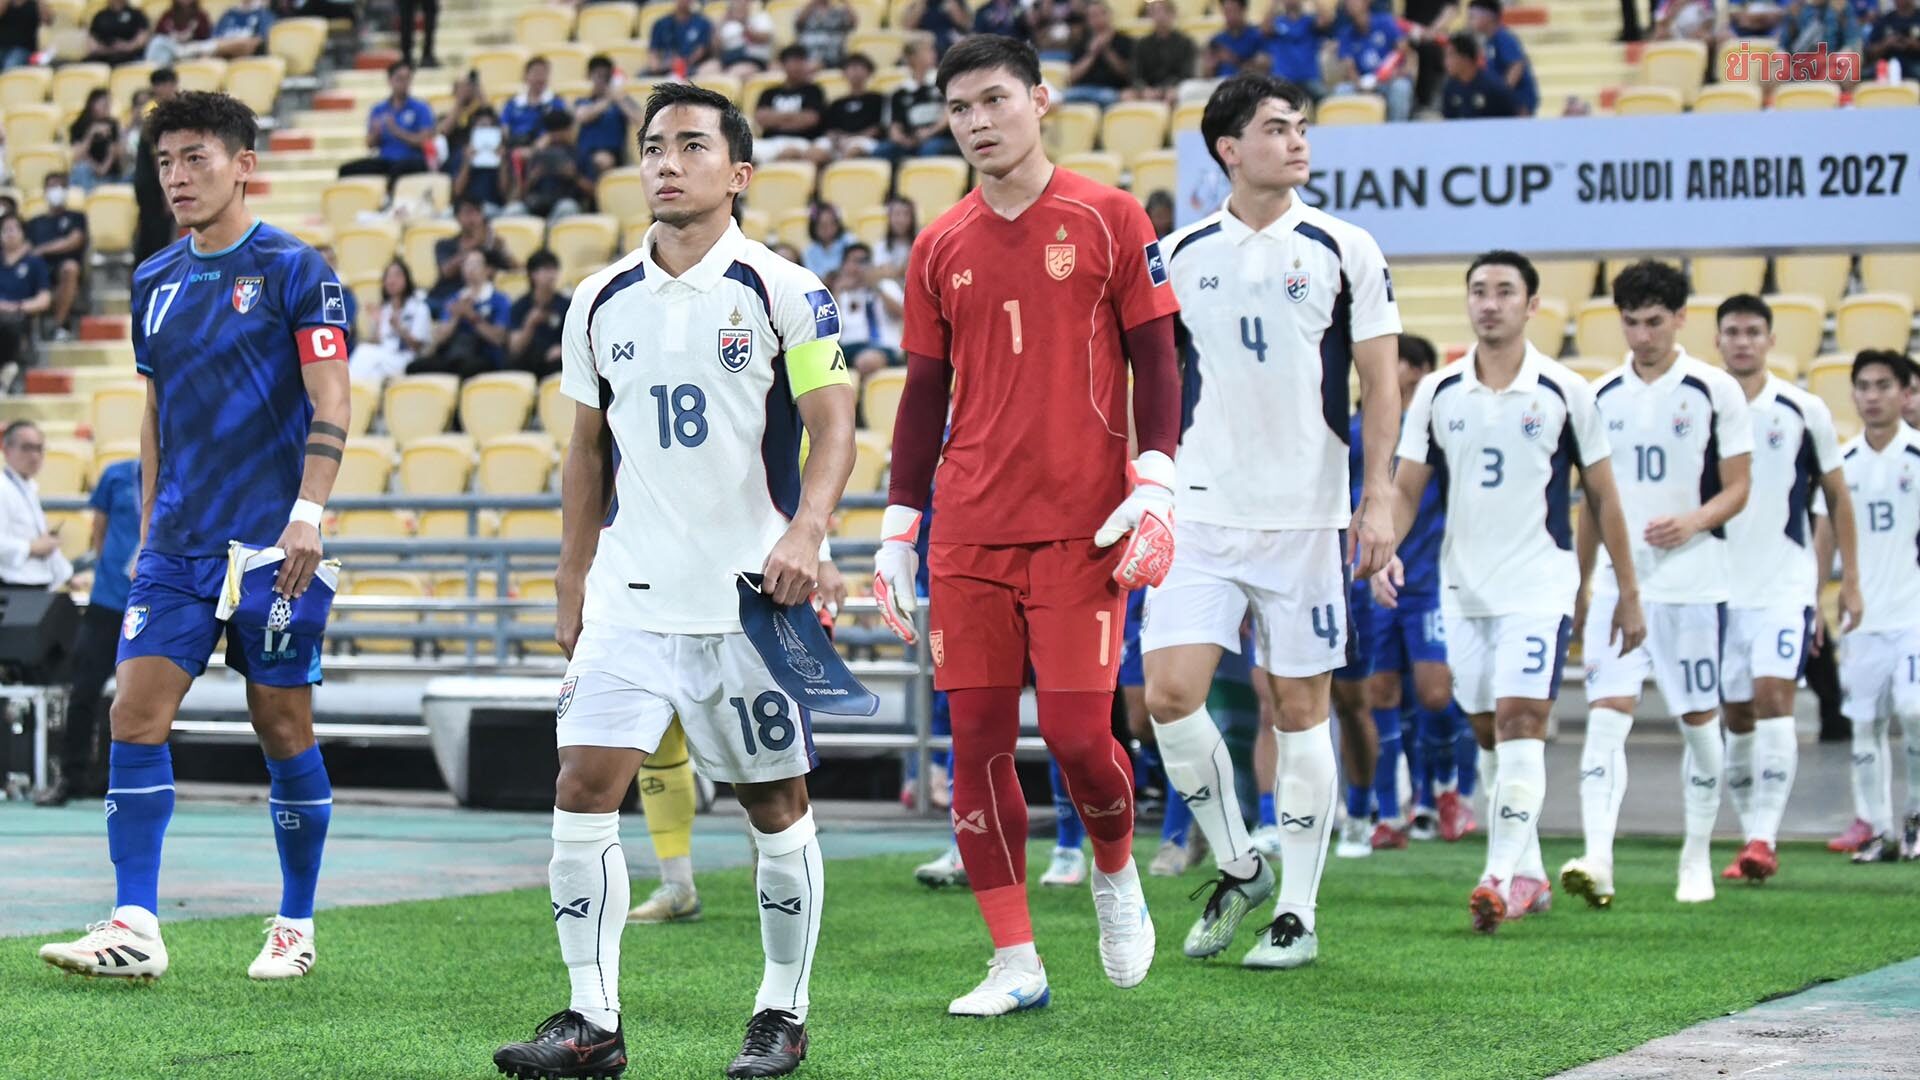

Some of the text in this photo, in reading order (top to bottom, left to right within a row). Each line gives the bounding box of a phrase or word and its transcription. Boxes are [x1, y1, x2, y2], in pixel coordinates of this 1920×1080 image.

[1304, 153, 1908, 210] SIAN CUP SAUDI ARABIA 2027
[145, 281, 181, 337] 17
[816, 302, 836, 319] AFC
[1003, 299, 1023, 355] 1
[311, 328, 337, 358] C
[1240, 317, 1267, 362] 4
[650, 383, 708, 449] 18
[1481, 448, 1504, 488] 3
[1634, 445, 1666, 483] 10
[1868, 501, 1894, 532] 13
[1096, 611, 1111, 666] 1
[1312, 604, 1337, 648] 4
[1777, 629, 1795, 659] 6
[1521, 636, 1546, 674] 3
[1907, 654, 1920, 684] 1
[1679, 658, 1717, 694] 10
[729, 690, 796, 756] 18
